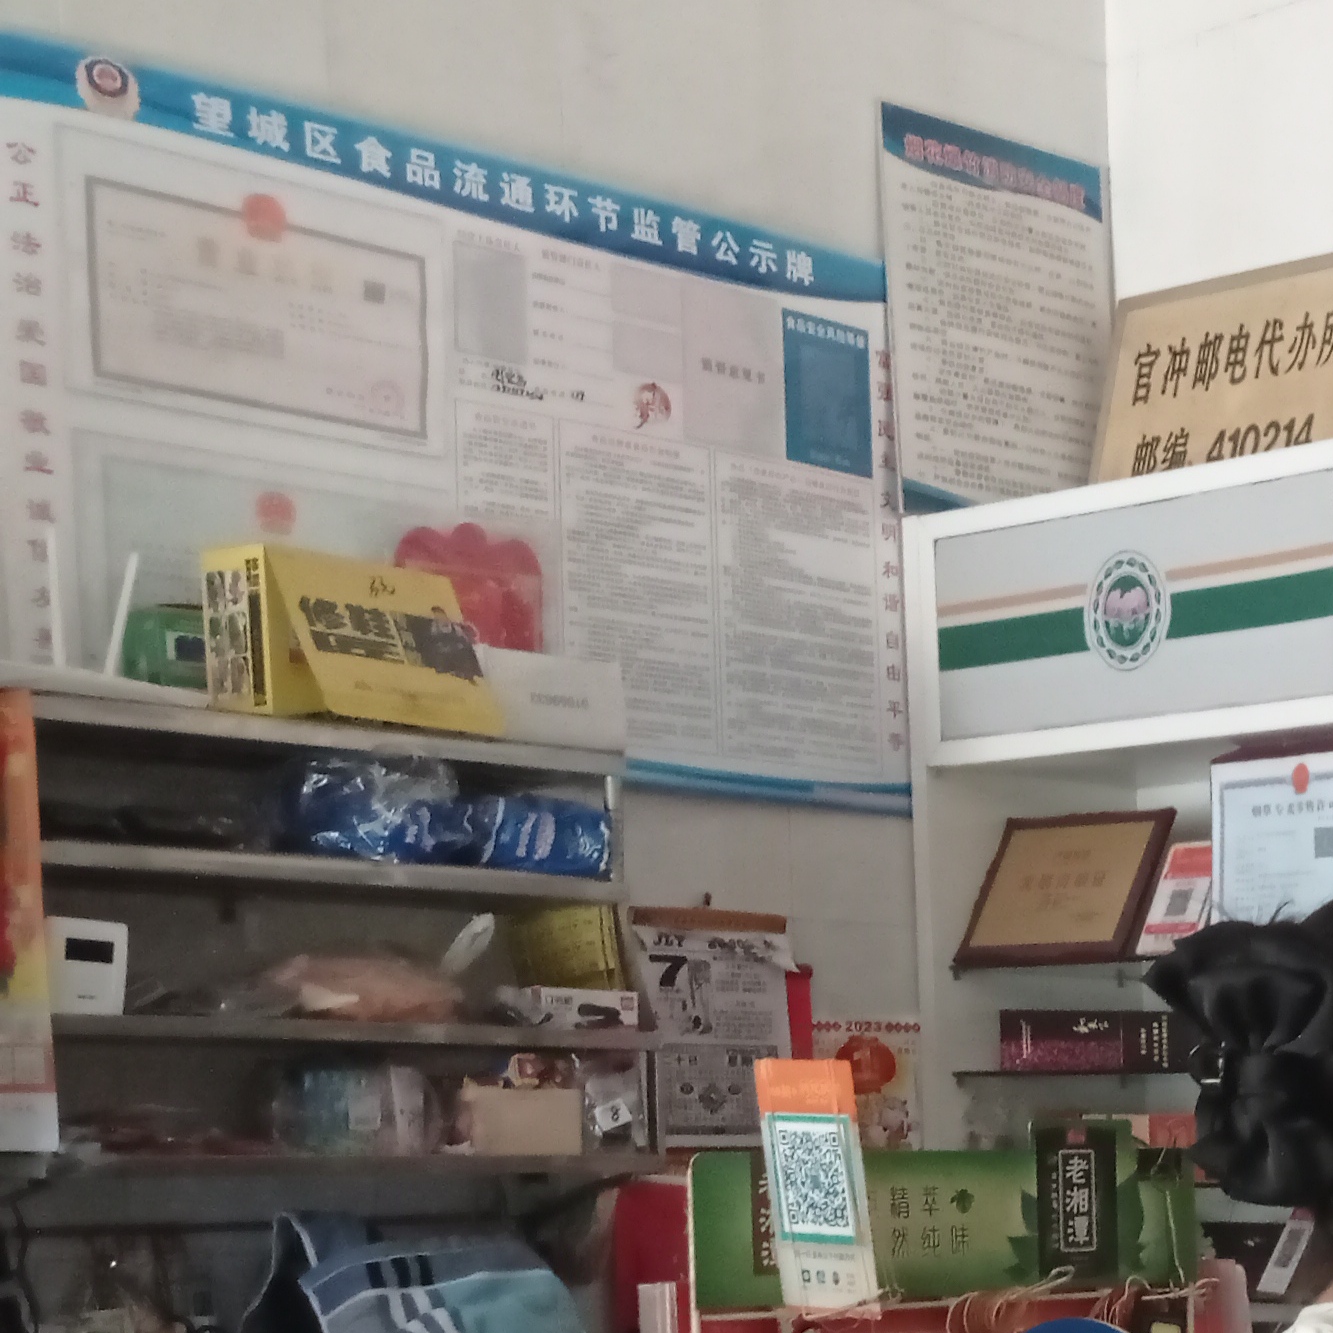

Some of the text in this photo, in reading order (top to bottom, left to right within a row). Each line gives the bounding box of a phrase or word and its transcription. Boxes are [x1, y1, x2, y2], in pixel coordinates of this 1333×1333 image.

[191, 91, 817, 288] 望城区食品流通环节监管公示牌
[1206, 413, 1315, 461] 410214
[649, 953, 688, 988] 7
[1063, 1156, 1092, 1246] 老湘潭
